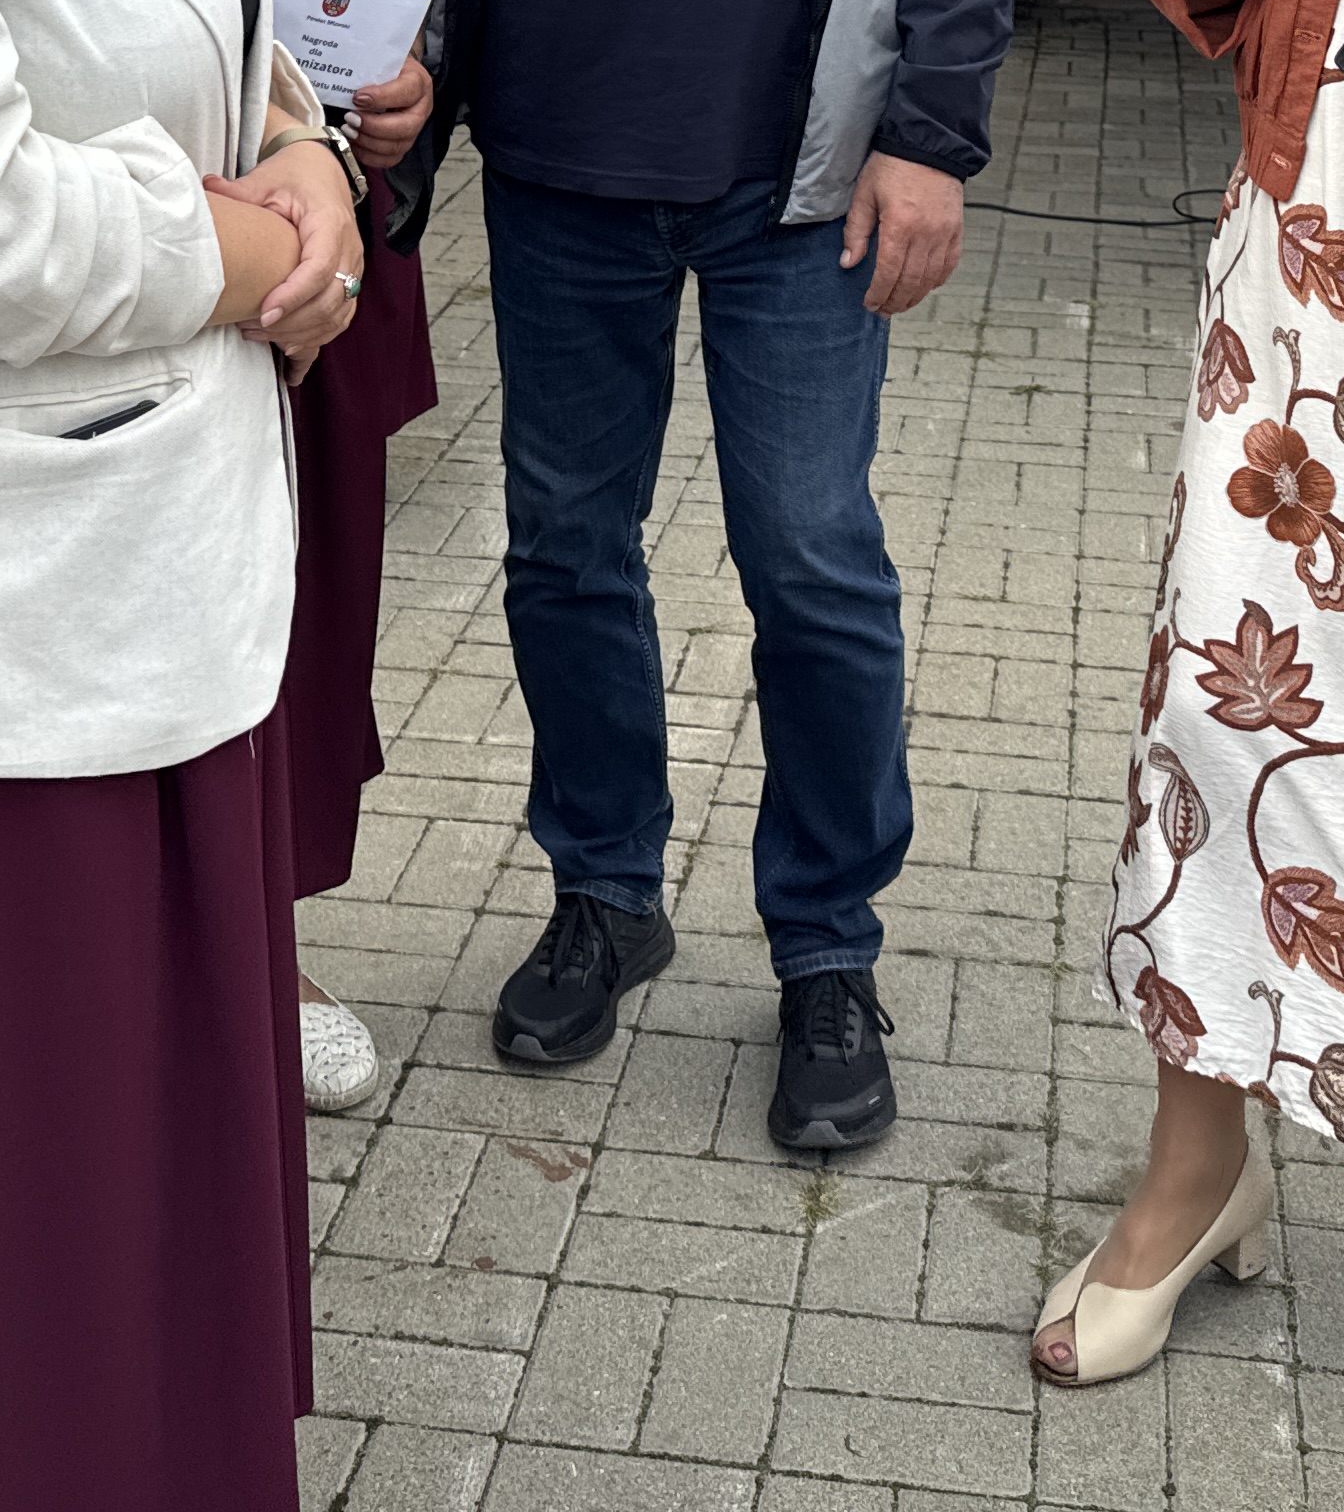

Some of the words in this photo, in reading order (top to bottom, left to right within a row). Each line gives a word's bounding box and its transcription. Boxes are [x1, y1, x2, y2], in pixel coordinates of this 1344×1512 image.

[302, 34, 339, 49] Nagroda
[309, 47, 323, 57] dla
[296, 58, 354, 77] anizatora
[331, 83, 358, 95] Mławs
